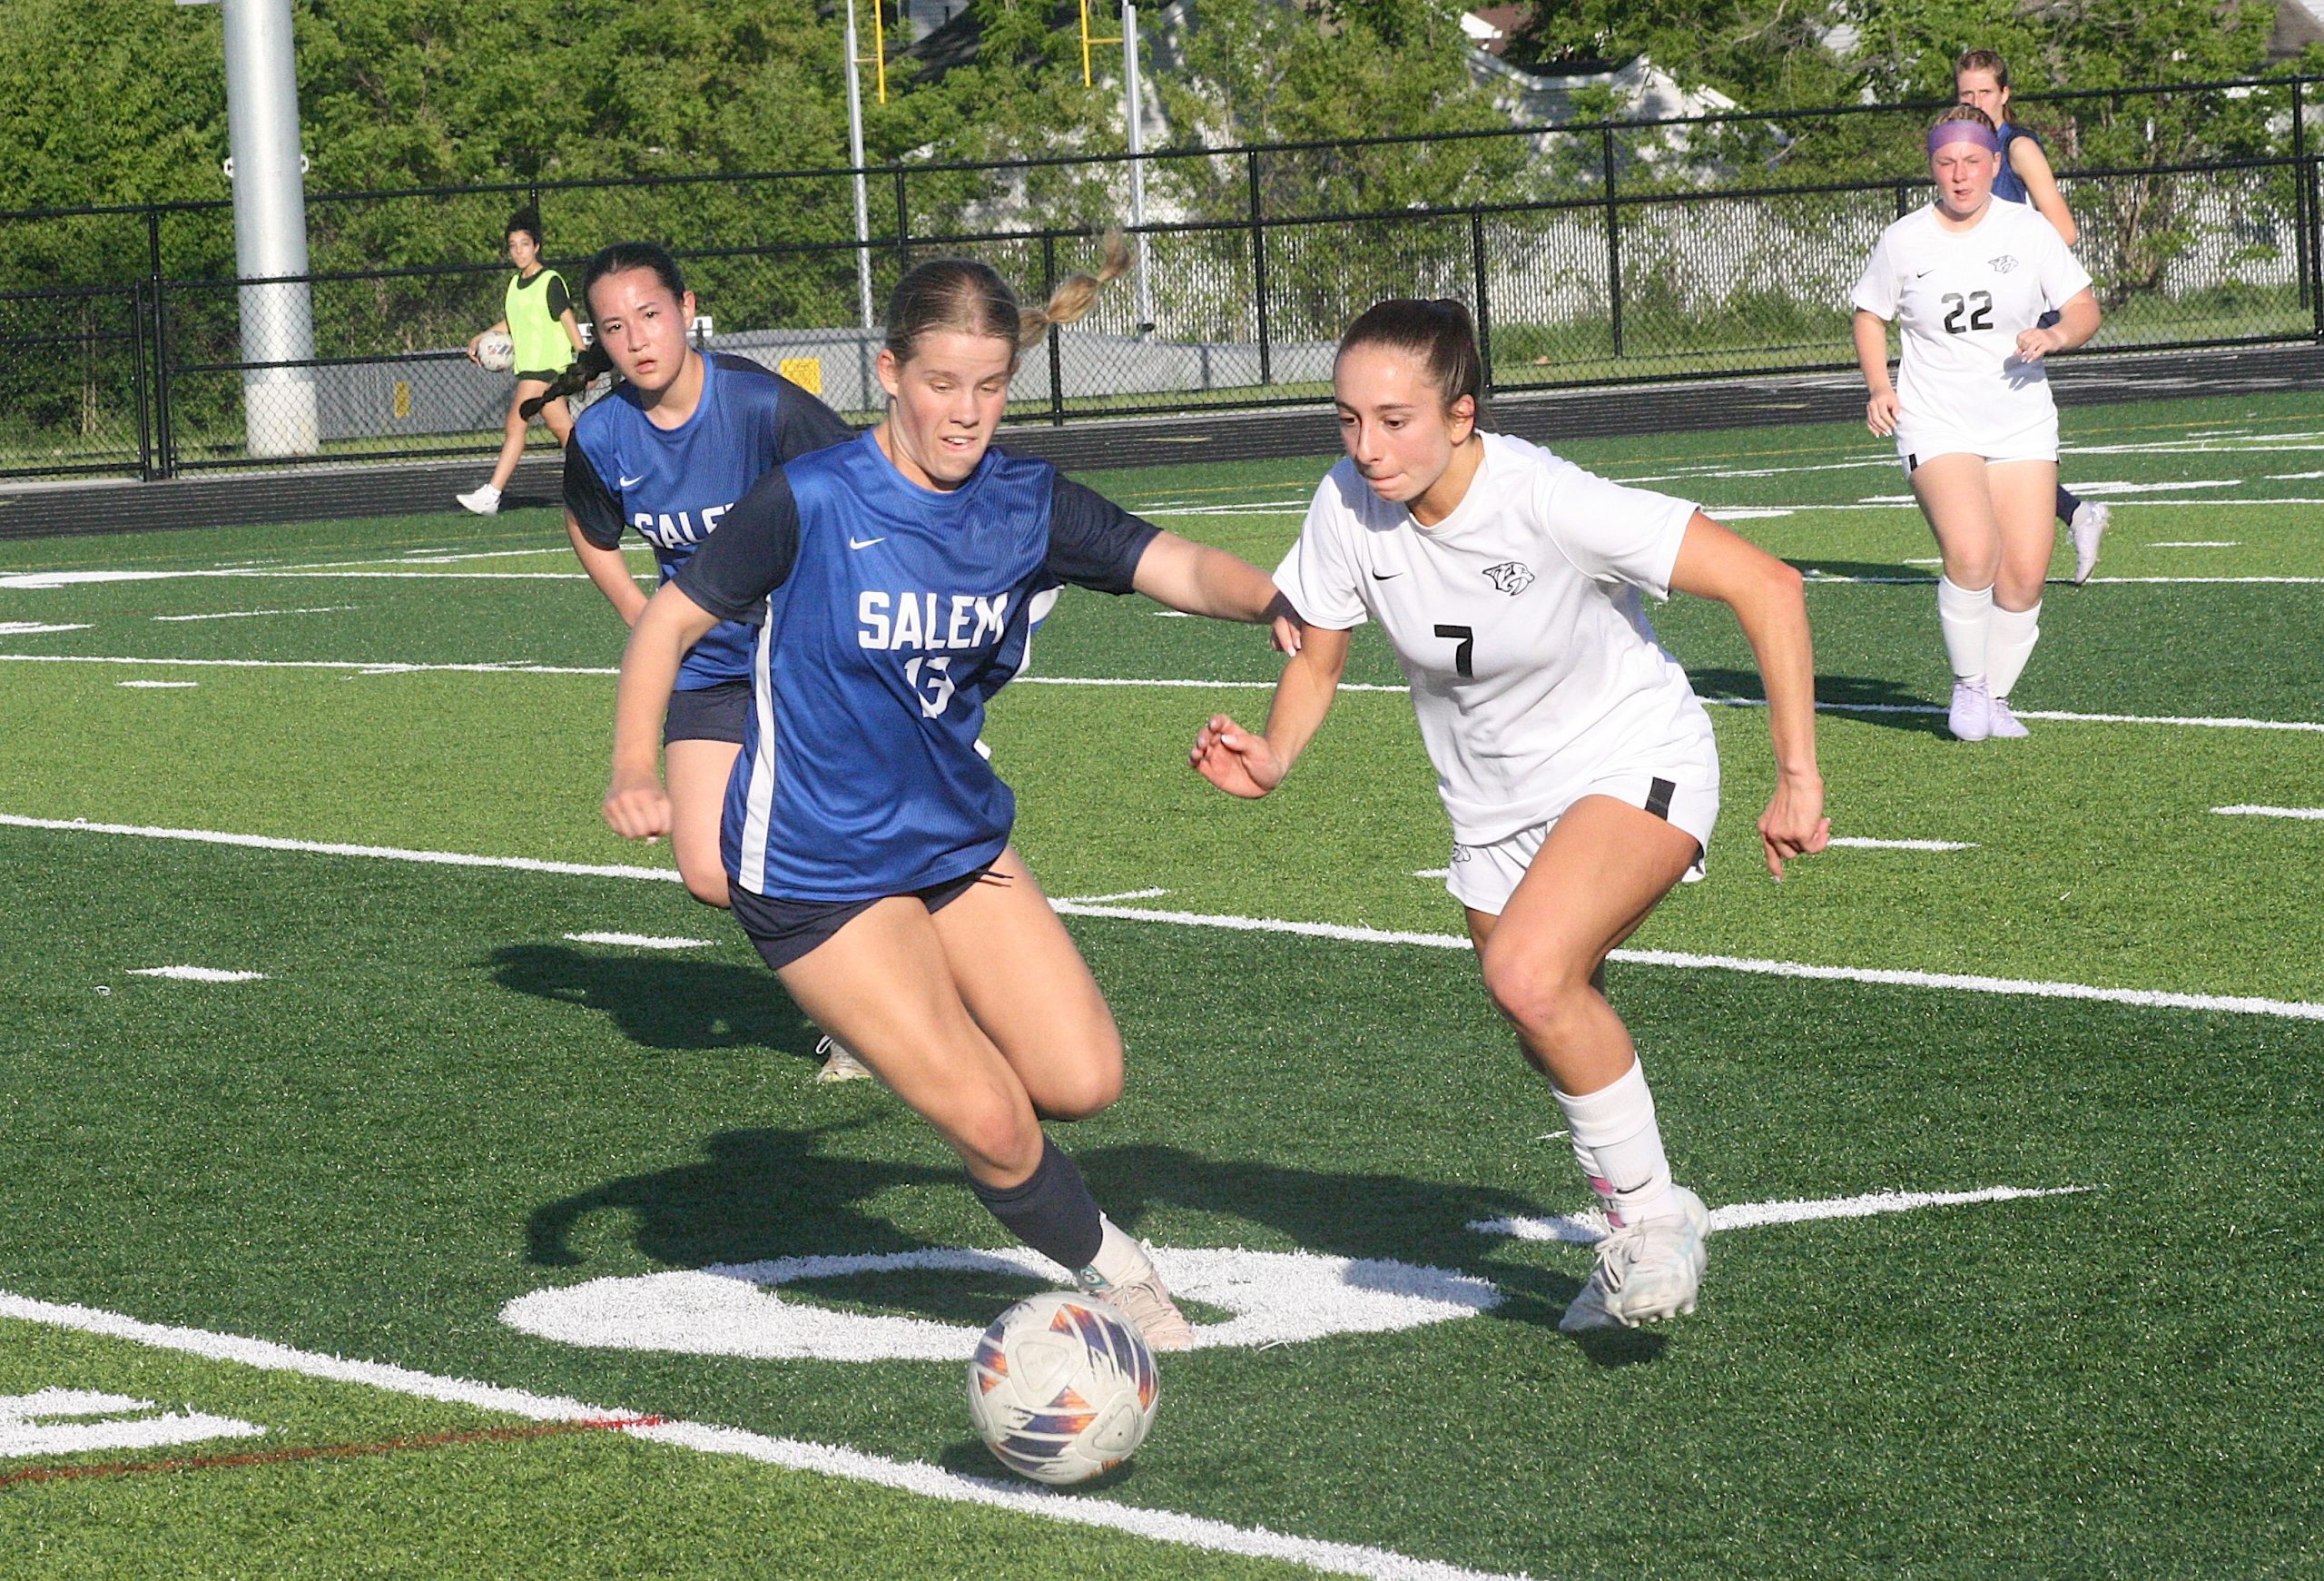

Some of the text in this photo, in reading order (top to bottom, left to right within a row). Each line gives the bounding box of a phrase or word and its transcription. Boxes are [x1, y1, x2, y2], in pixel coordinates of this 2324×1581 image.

[1941, 290, 1994, 334] 22
[634, 502, 734, 549] SALE
[858, 590, 1009, 650] SALEM
[1433, 624, 1474, 680] 7
[903, 656, 956, 719] 13
